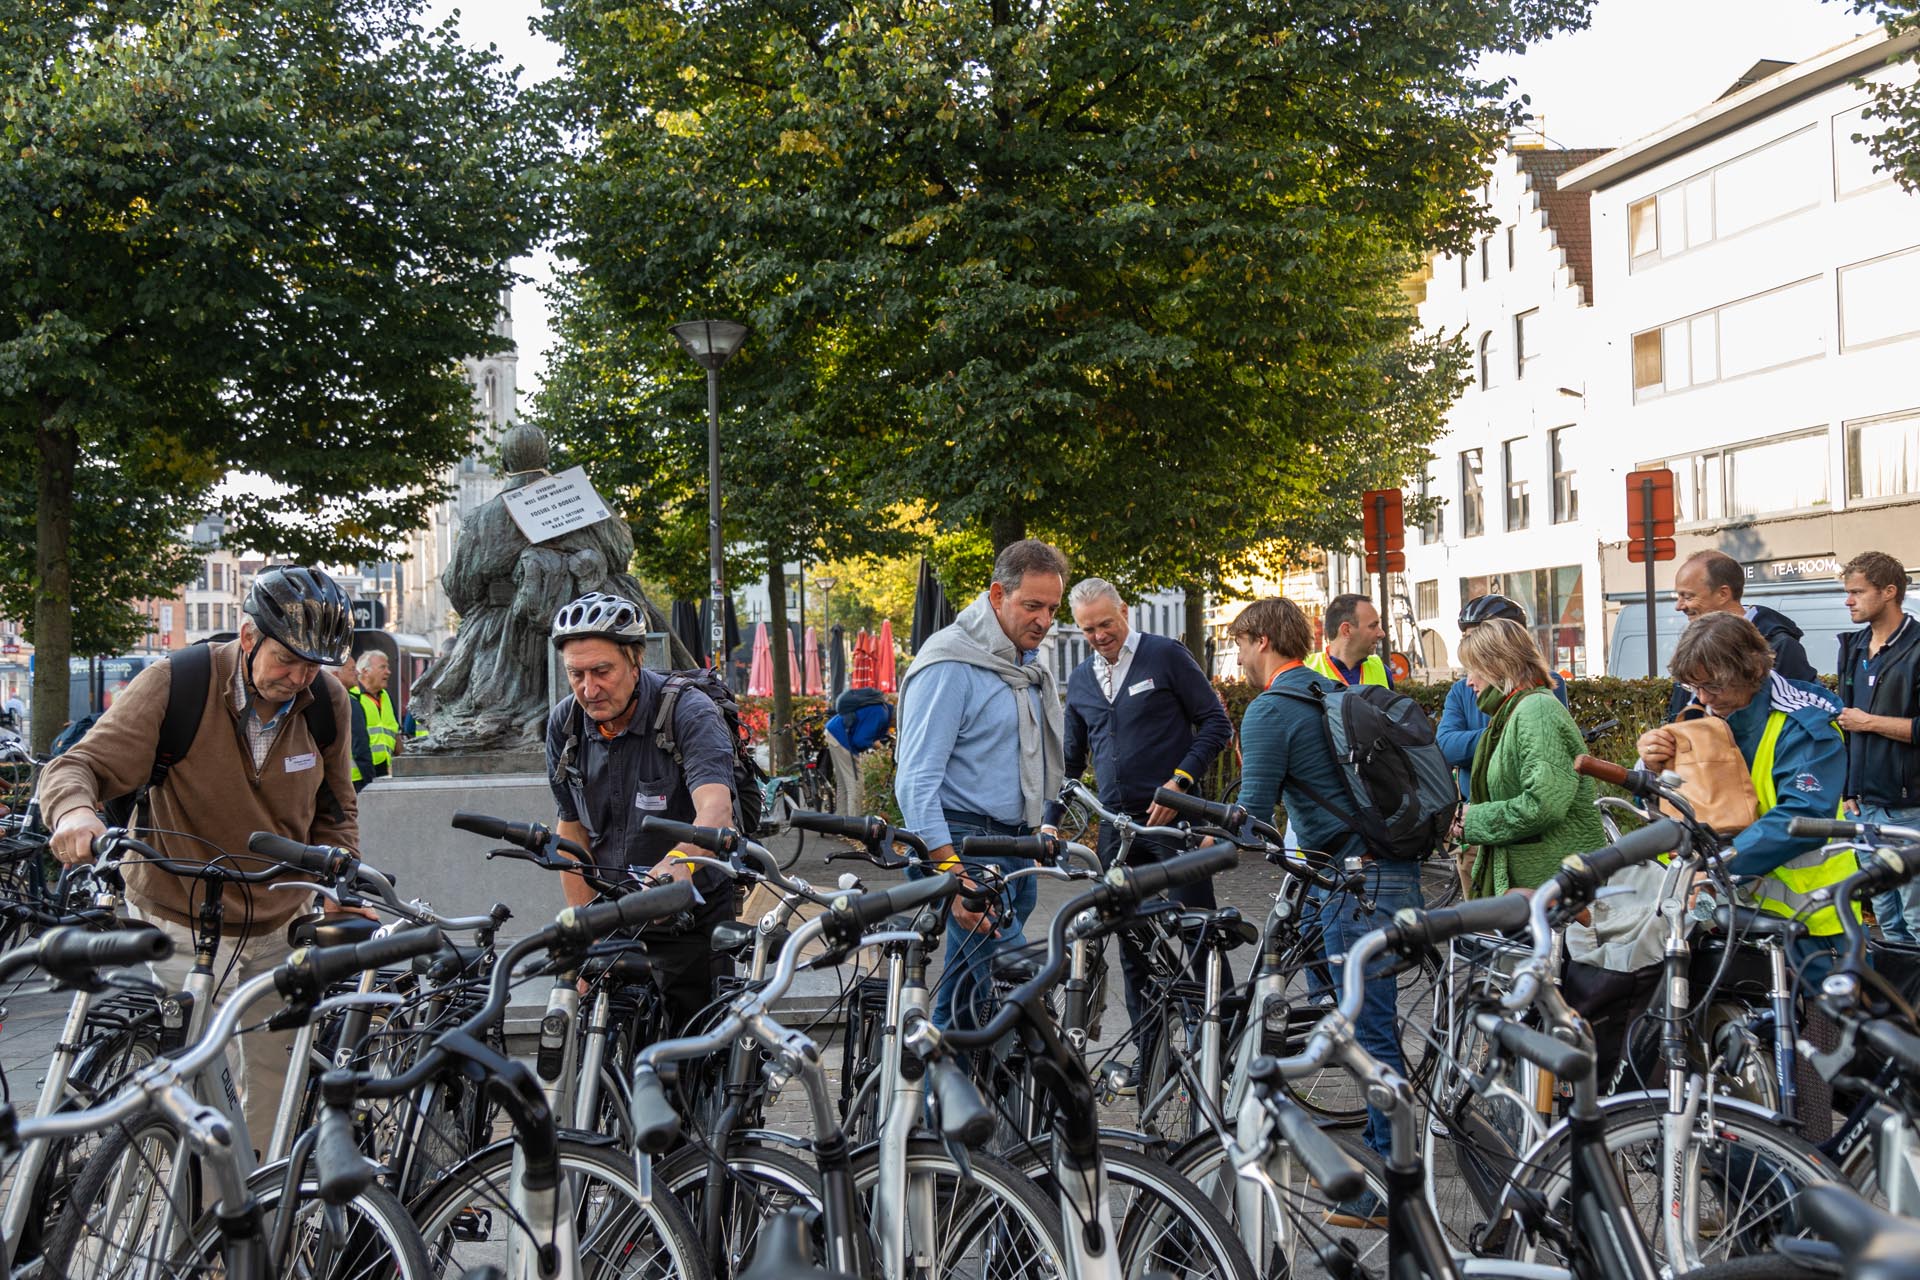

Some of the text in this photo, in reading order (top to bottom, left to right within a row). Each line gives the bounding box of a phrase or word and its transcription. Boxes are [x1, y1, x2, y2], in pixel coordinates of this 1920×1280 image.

[530, 507, 550, 517] FOSSIEL
[558, 496, 581, 507] DODELIJK
[1771, 558, 1836, 576] TEA-ROOM
[1774, 1041, 1784, 1087] Gazelle
